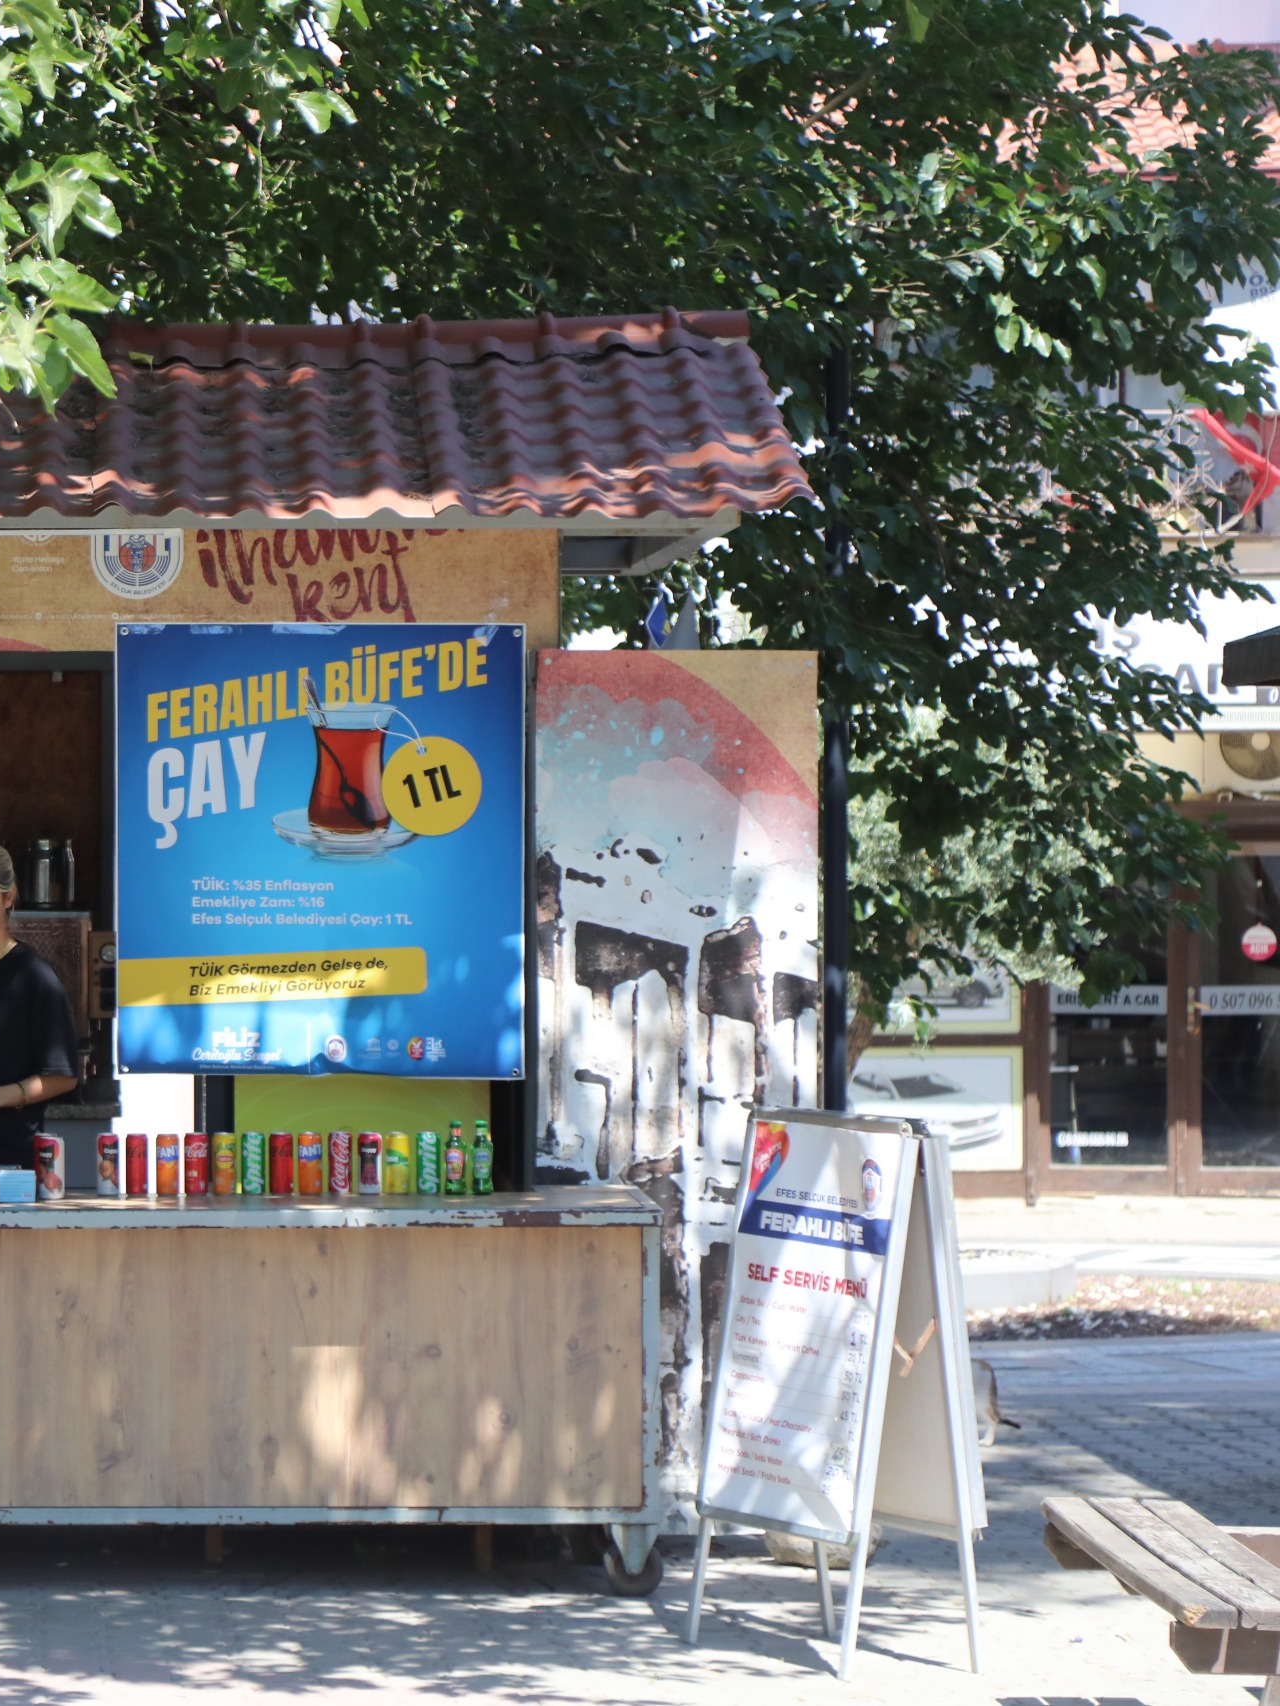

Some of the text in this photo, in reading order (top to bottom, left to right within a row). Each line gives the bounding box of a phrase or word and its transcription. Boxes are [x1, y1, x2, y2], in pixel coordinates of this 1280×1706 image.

[12, 556, 65, 565] World Heritage
[12, 565, 53, 573] Convention
[147, 636, 488, 743] FERAHLI BÜFE'DE
[148, 731, 267, 850] ÇAY
[402, 764, 462, 809] 1 TL
[192, 876, 334, 896] TÜİK: %35 Enflasyon
[192, 895, 325, 910] Emekliye Zam: %16
[192, 912, 412, 928] Efes Selçuk Belediyesi Çay: 1 TL
[189, 956, 389, 978] TÜİK Görmezden Gelse de,
[189, 976, 367, 997] Biz Emekliyi Görüyoruz
[1124, 993, 1132, 1006] A
[1135, 993, 1159, 1006] CAR
[1209, 990, 1273, 1009] 0 507 096
[243, 1133, 265, 1193] Sprite
[418, 1132, 439, 1193] Sprite
[776, 1187, 797, 1200] EFES
[760, 1210, 865, 1246] FERAHLI BÜFE
[747, 1262, 868, 1300] SELF SERVİS MENÜ
[789, 1304, 808, 1314] Water
[850, 1331, 856, 1347] 1
[859, 1333, 868, 1346] TL
[855, 1371, 863, 1384] TL
[852, 1391, 861, 1404] TL
[769, 1417, 781, 1427] Hot
[781, 1420, 813, 1434] Chocolate
